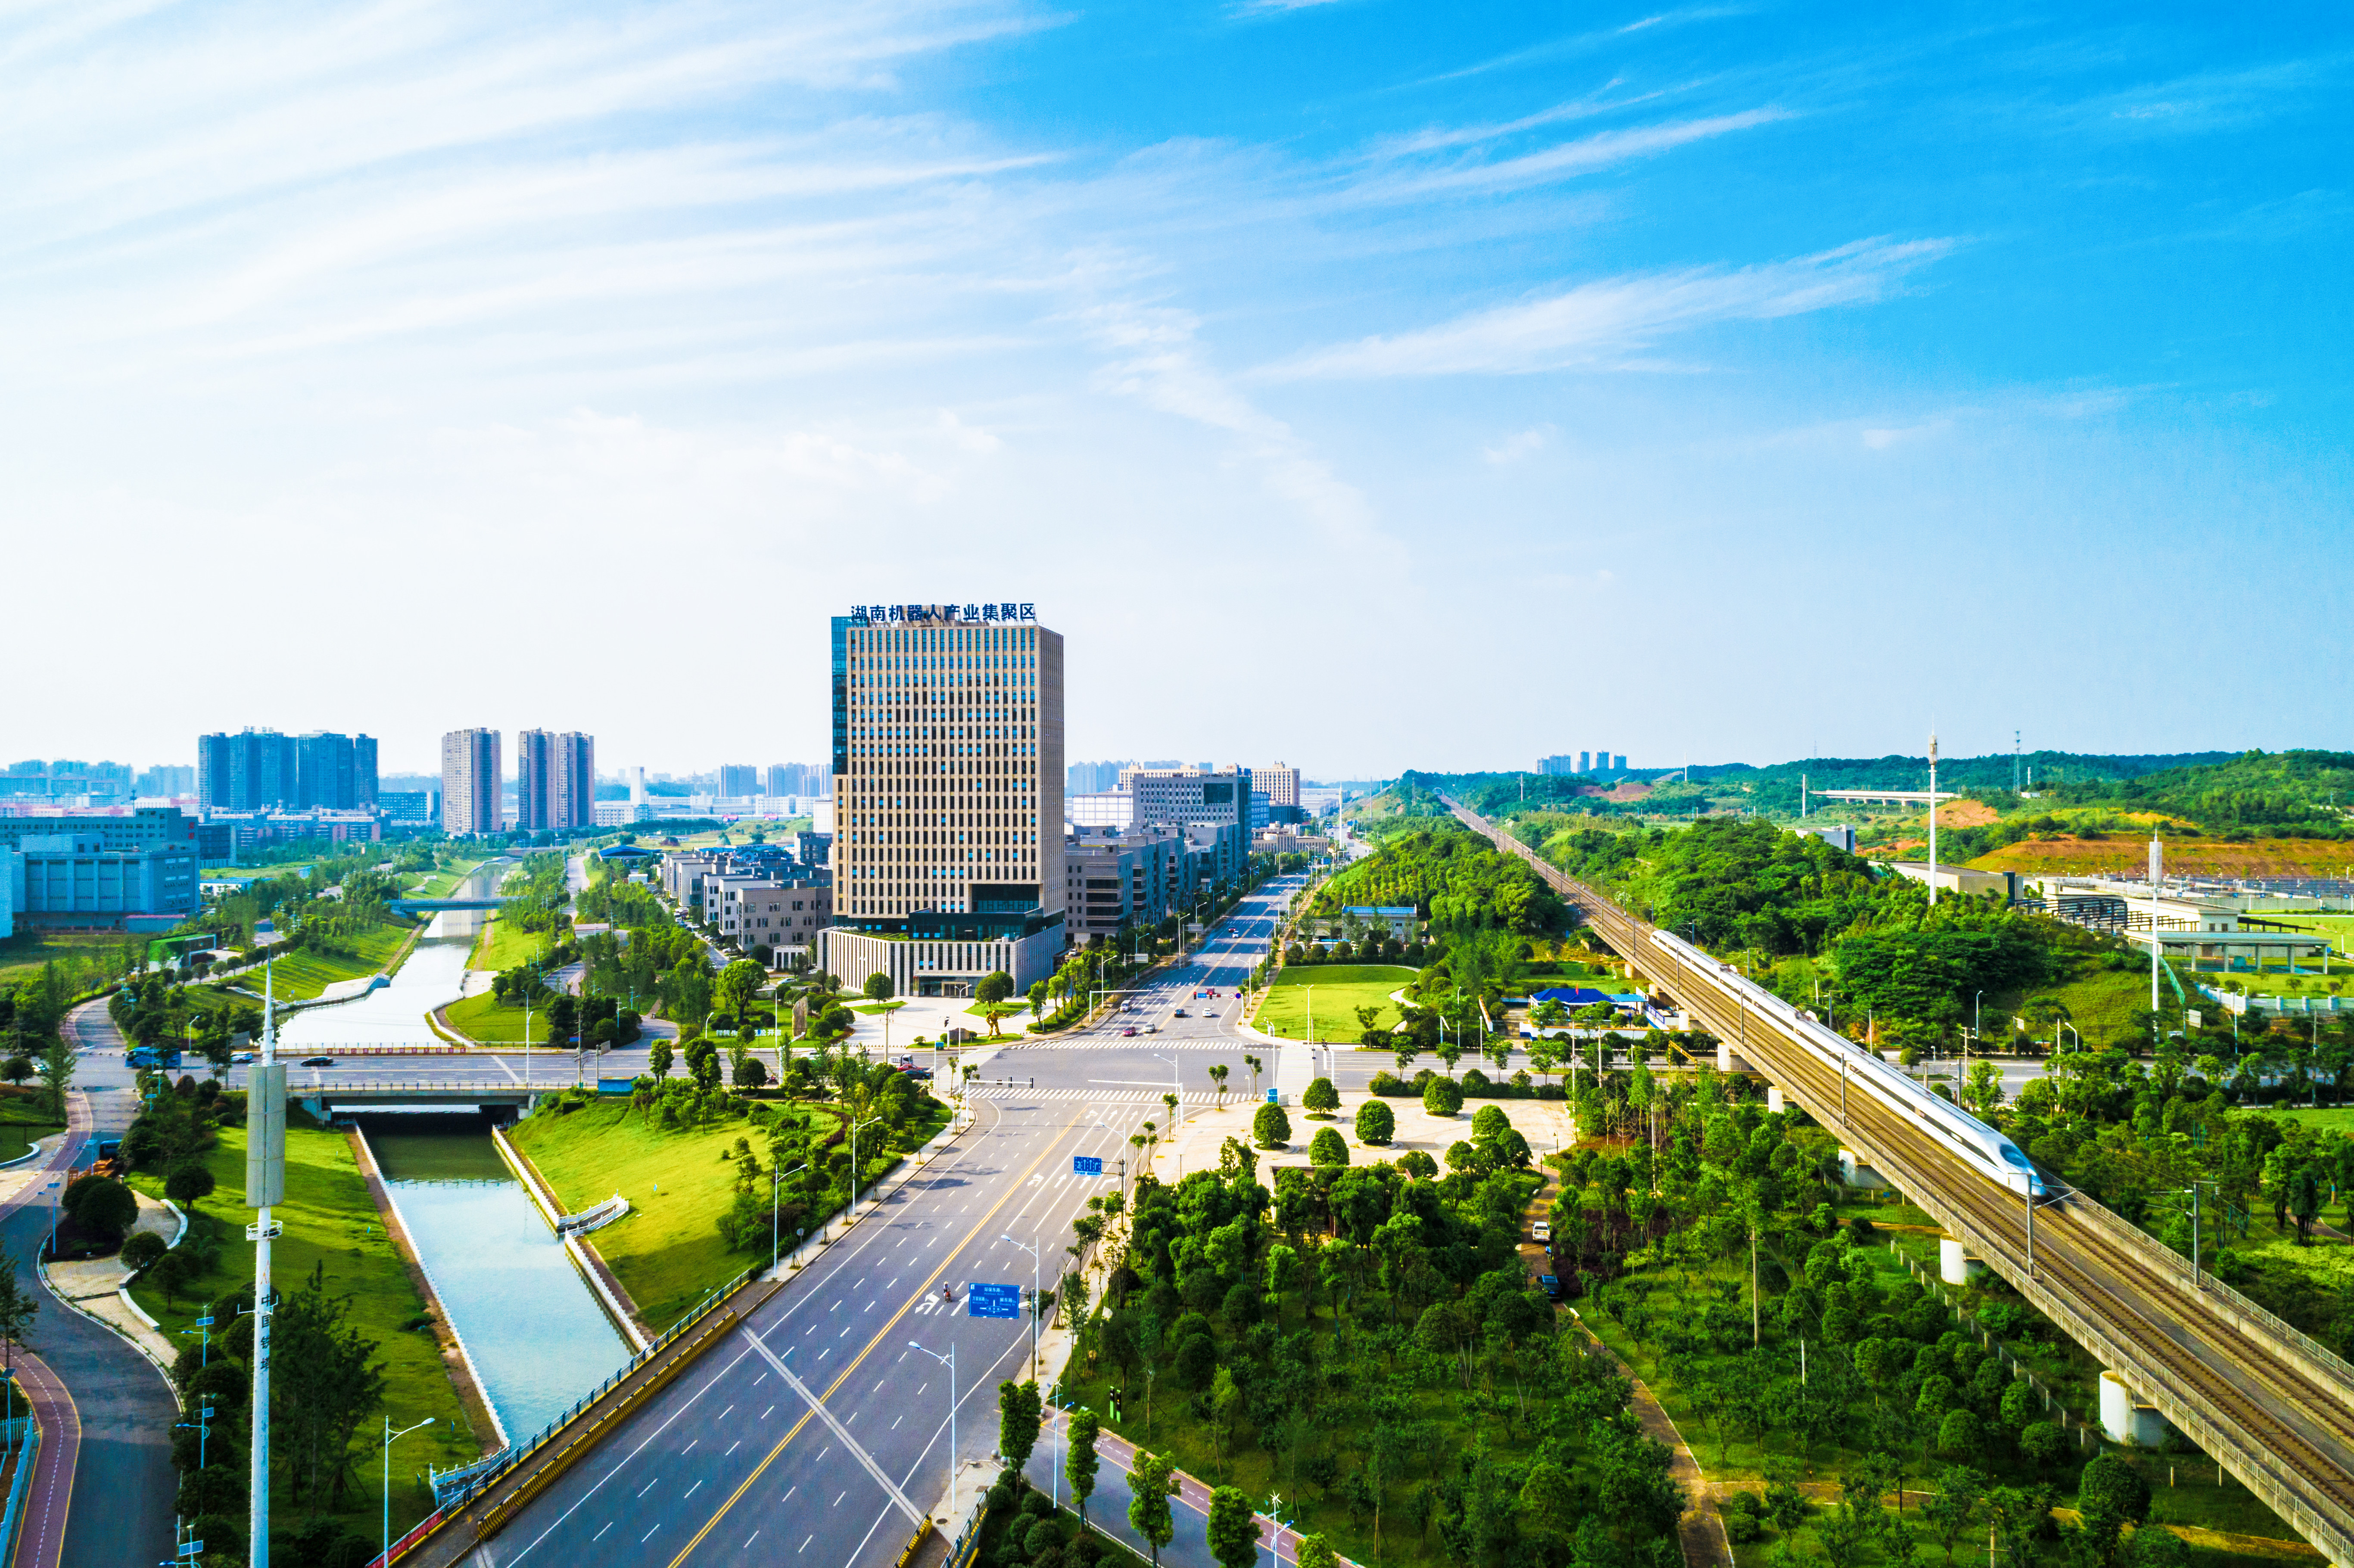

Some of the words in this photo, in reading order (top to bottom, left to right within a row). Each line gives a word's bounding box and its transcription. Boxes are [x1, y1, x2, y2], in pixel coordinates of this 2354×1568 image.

[851, 604, 1035, 622] 湖南机器人产业集聚区
[260, 1294, 270, 1372] 中国铁塔
